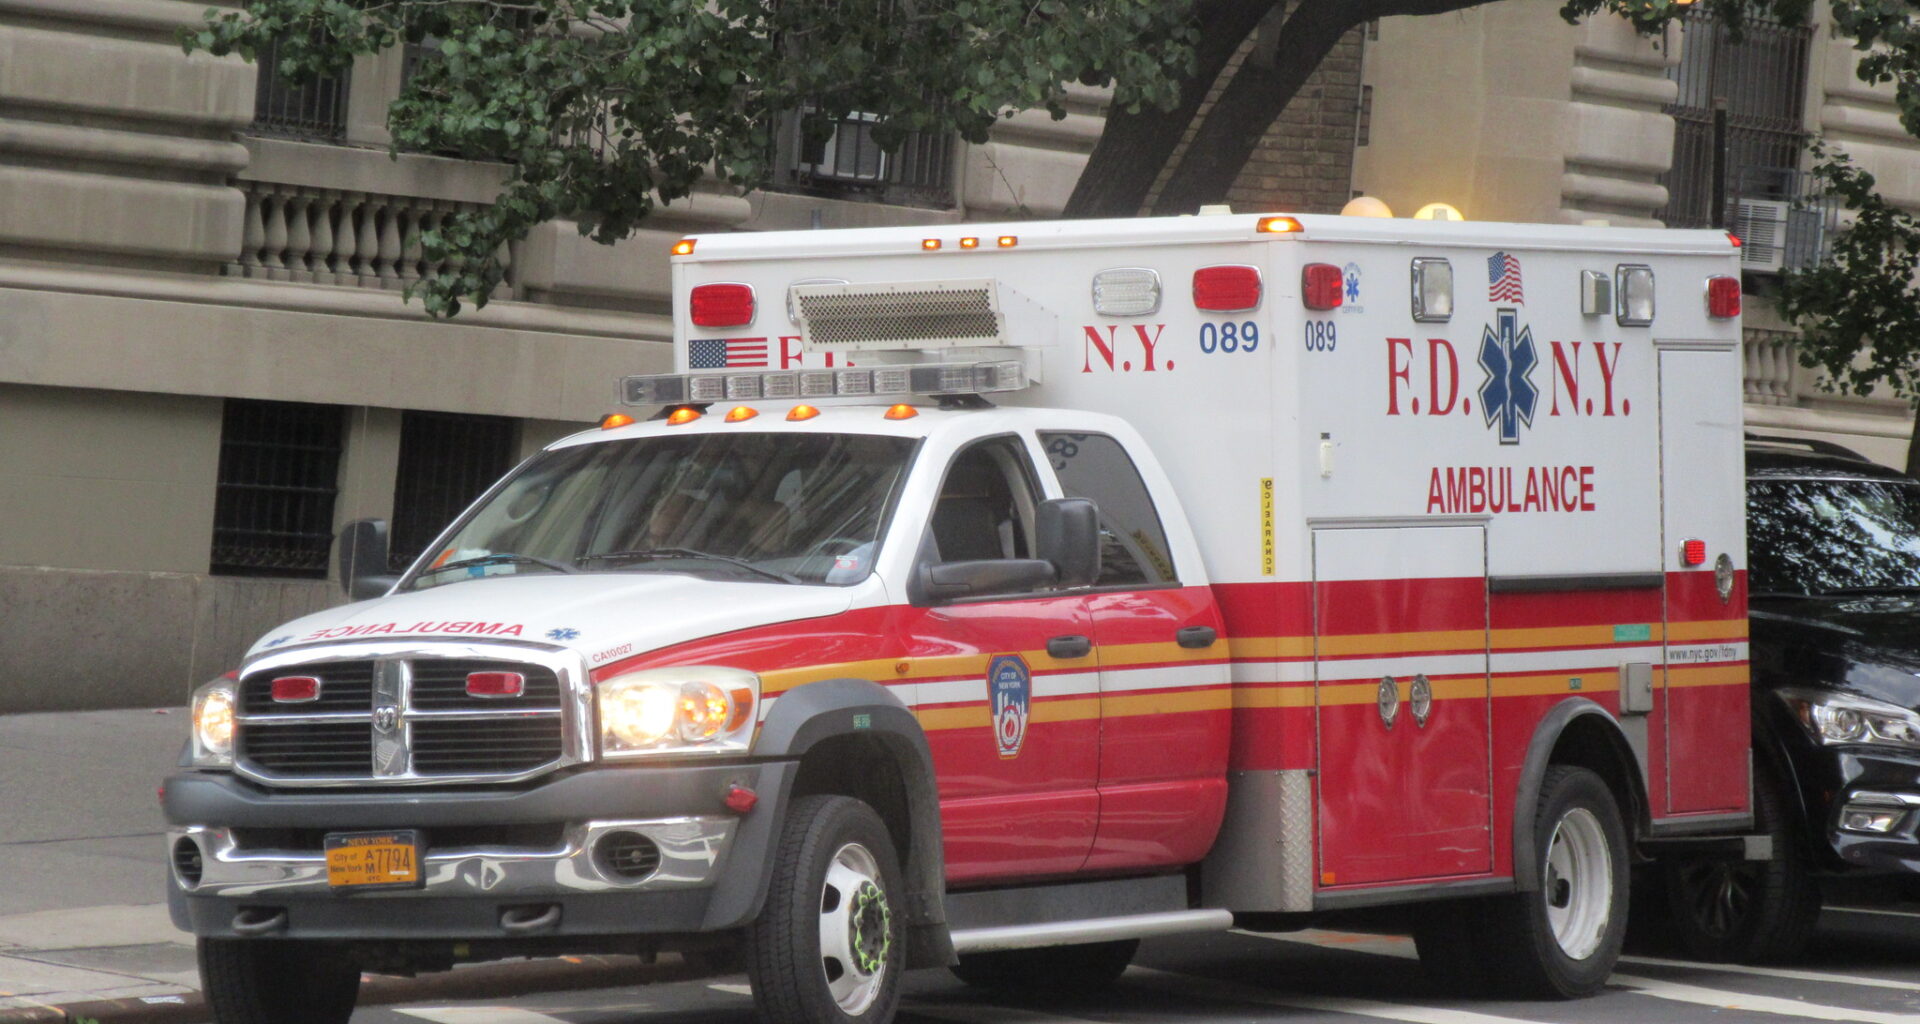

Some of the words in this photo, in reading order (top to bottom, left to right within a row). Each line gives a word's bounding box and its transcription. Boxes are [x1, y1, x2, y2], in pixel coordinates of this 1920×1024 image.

[1082, 324, 1175, 373] N.Y.
[1200, 321, 1259, 354] 089
[1305, 320, 1336, 352] 089
[1386, 337, 1471, 416] F.D.
[1550, 341, 1631, 416] N.Y.
[1426, 465, 1596, 514] AMBULANCE
[592, 643, 633, 663] CA10027
[349, 838, 369, 847] NEW
[375, 848, 410, 873] 7794
